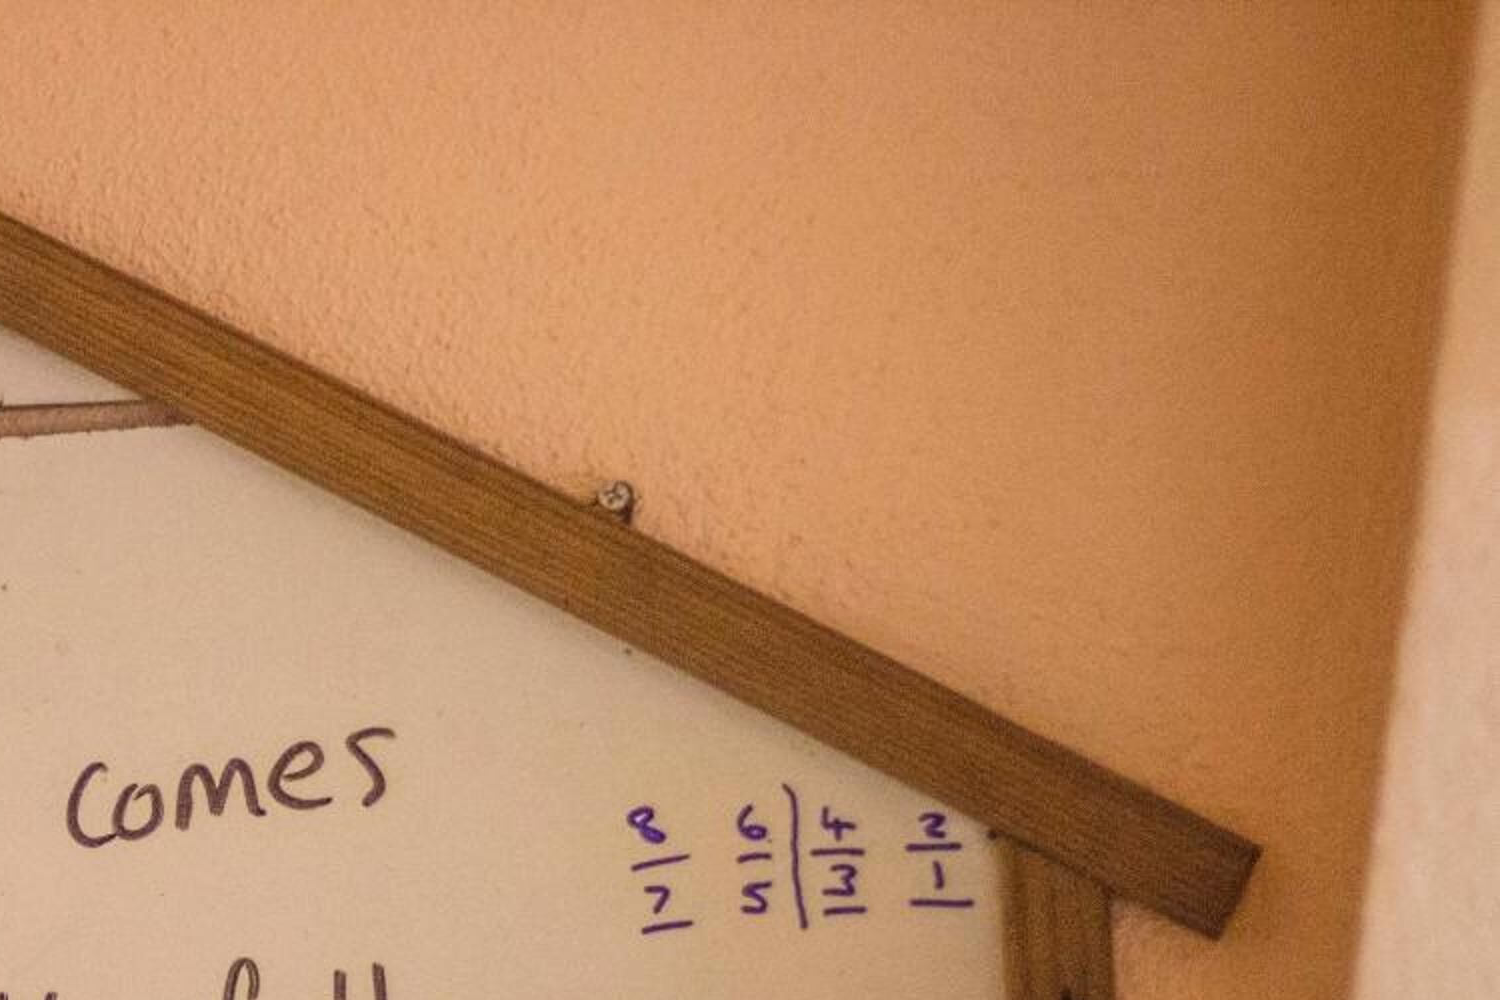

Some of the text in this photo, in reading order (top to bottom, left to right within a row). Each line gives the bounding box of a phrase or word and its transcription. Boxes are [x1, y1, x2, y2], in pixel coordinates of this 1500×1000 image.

[66, 726, 397, 848] comes
[625, 803, 947, 846] 8 6 4 2
[643, 860, 946, 916] 7 5 3 1
